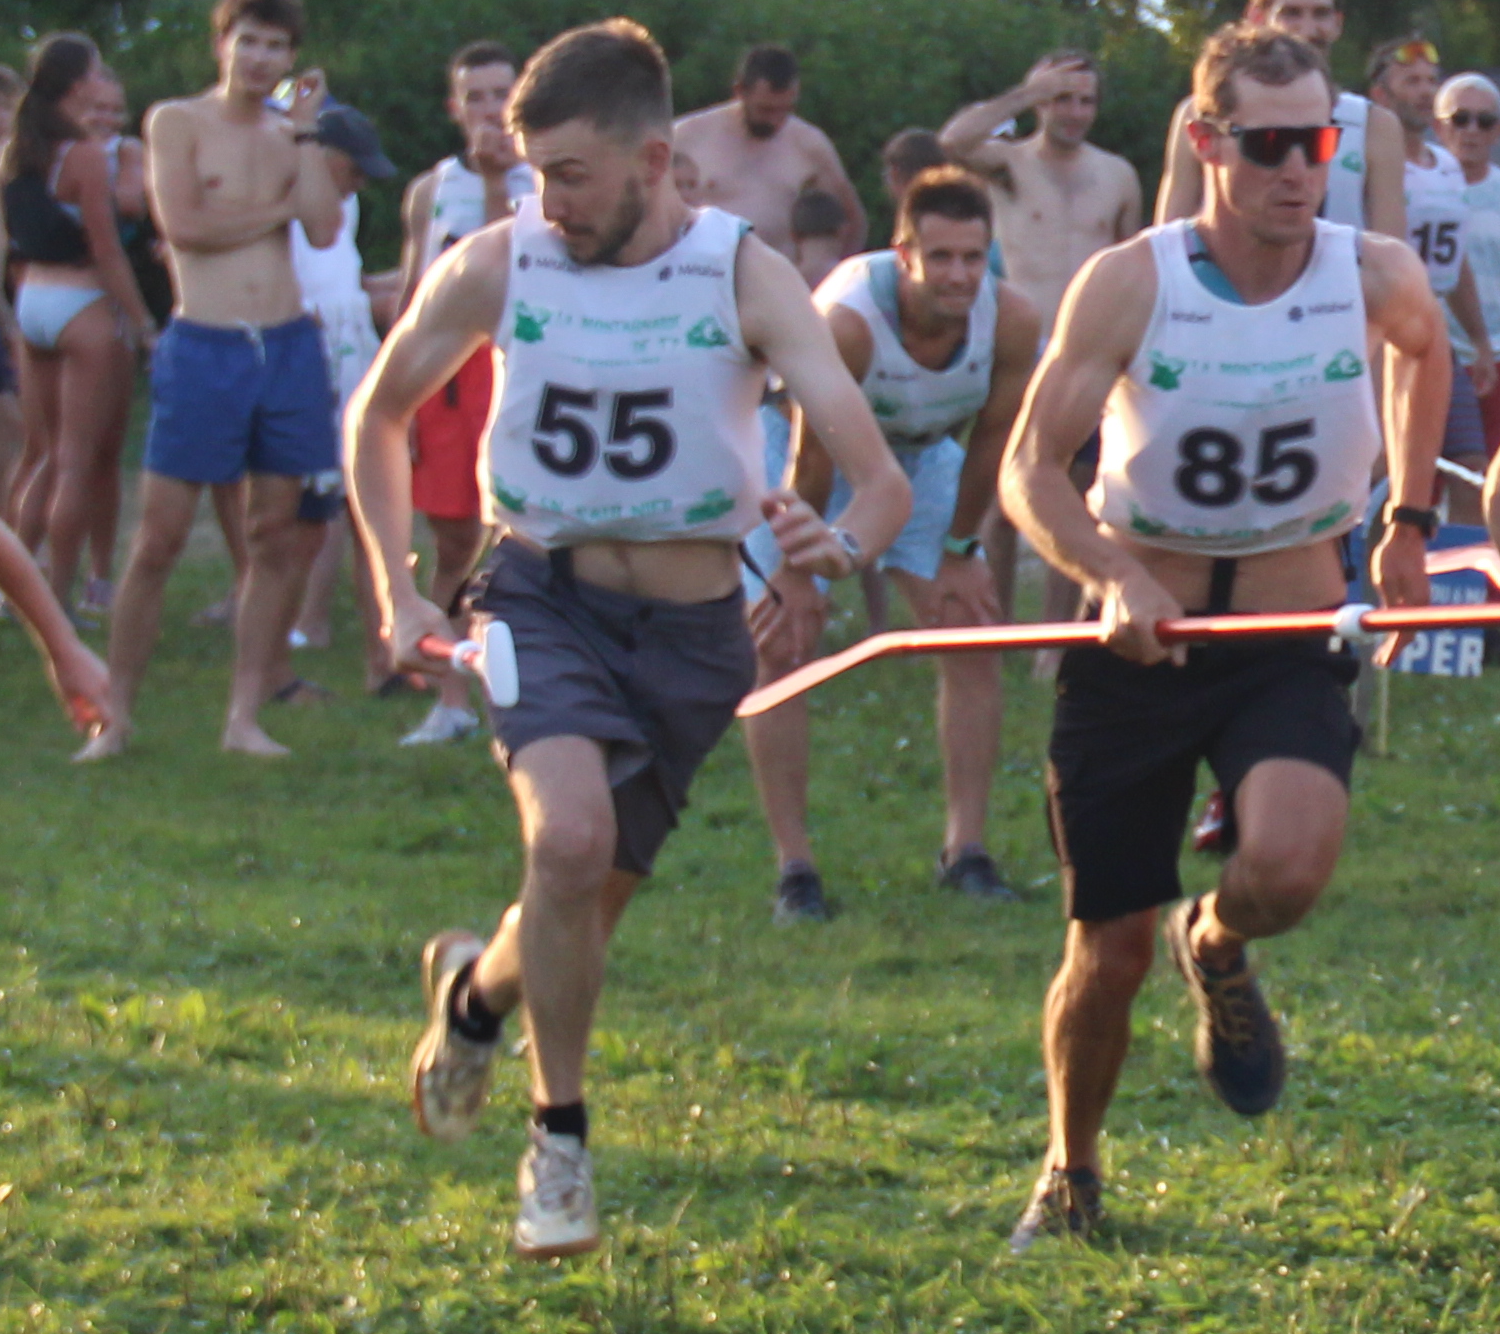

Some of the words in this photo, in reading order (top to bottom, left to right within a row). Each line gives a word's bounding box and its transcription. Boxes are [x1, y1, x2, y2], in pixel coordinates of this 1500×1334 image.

[1411, 222, 1461, 265] 15
[532, 381, 678, 482] 55
[1174, 417, 1318, 508] 85
